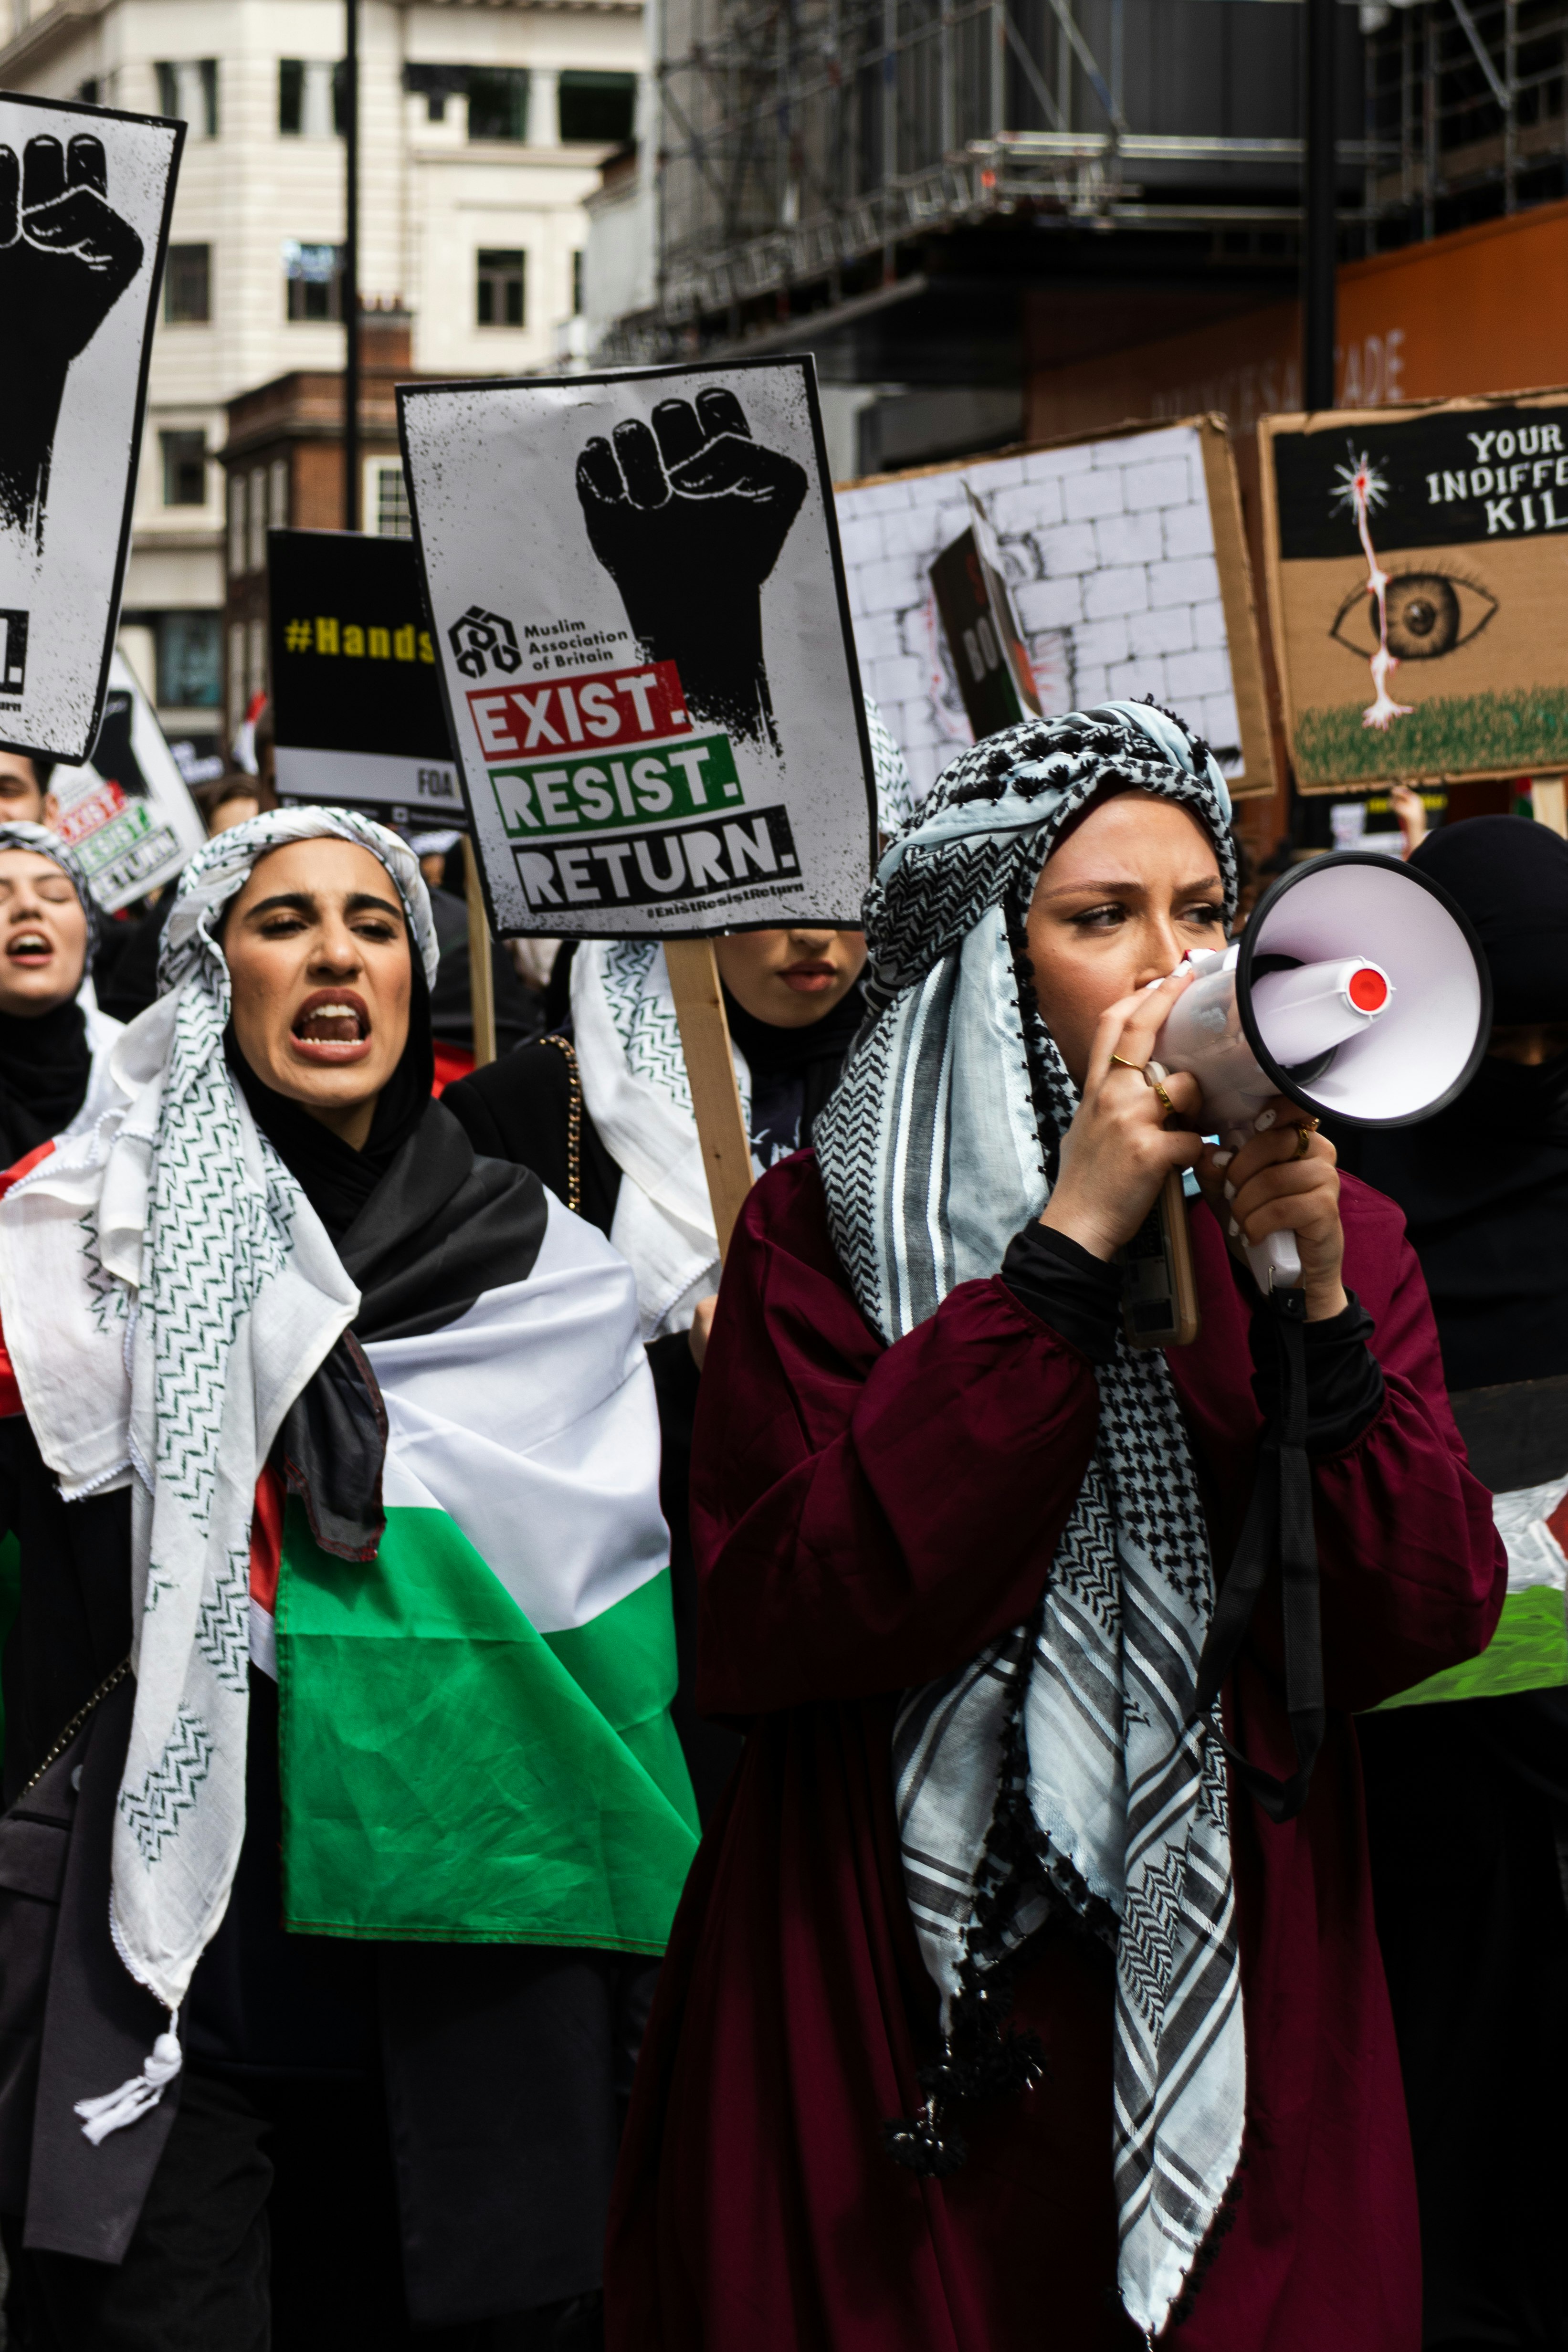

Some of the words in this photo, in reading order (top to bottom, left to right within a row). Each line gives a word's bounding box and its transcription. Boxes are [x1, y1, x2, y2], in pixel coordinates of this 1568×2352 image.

[1467, 423, 1565, 463] YOUR
[1426, 455, 1568, 504] INDIFFE
[1484, 489, 1568, 535] KIL
[285, 616, 435, 664] #Hands
[524, 619, 586, 639] Muslim
[529, 630, 628, 655] Association
[532, 655, 550, 671] of
[554, 648, 614, 668] Britain
[471, 672, 687, 753] EXIST.
[493, 745, 739, 830] RESIST.
[515, 816, 797, 906] RETURN.
[647, 883, 805, 919] #ExistResistReturn
